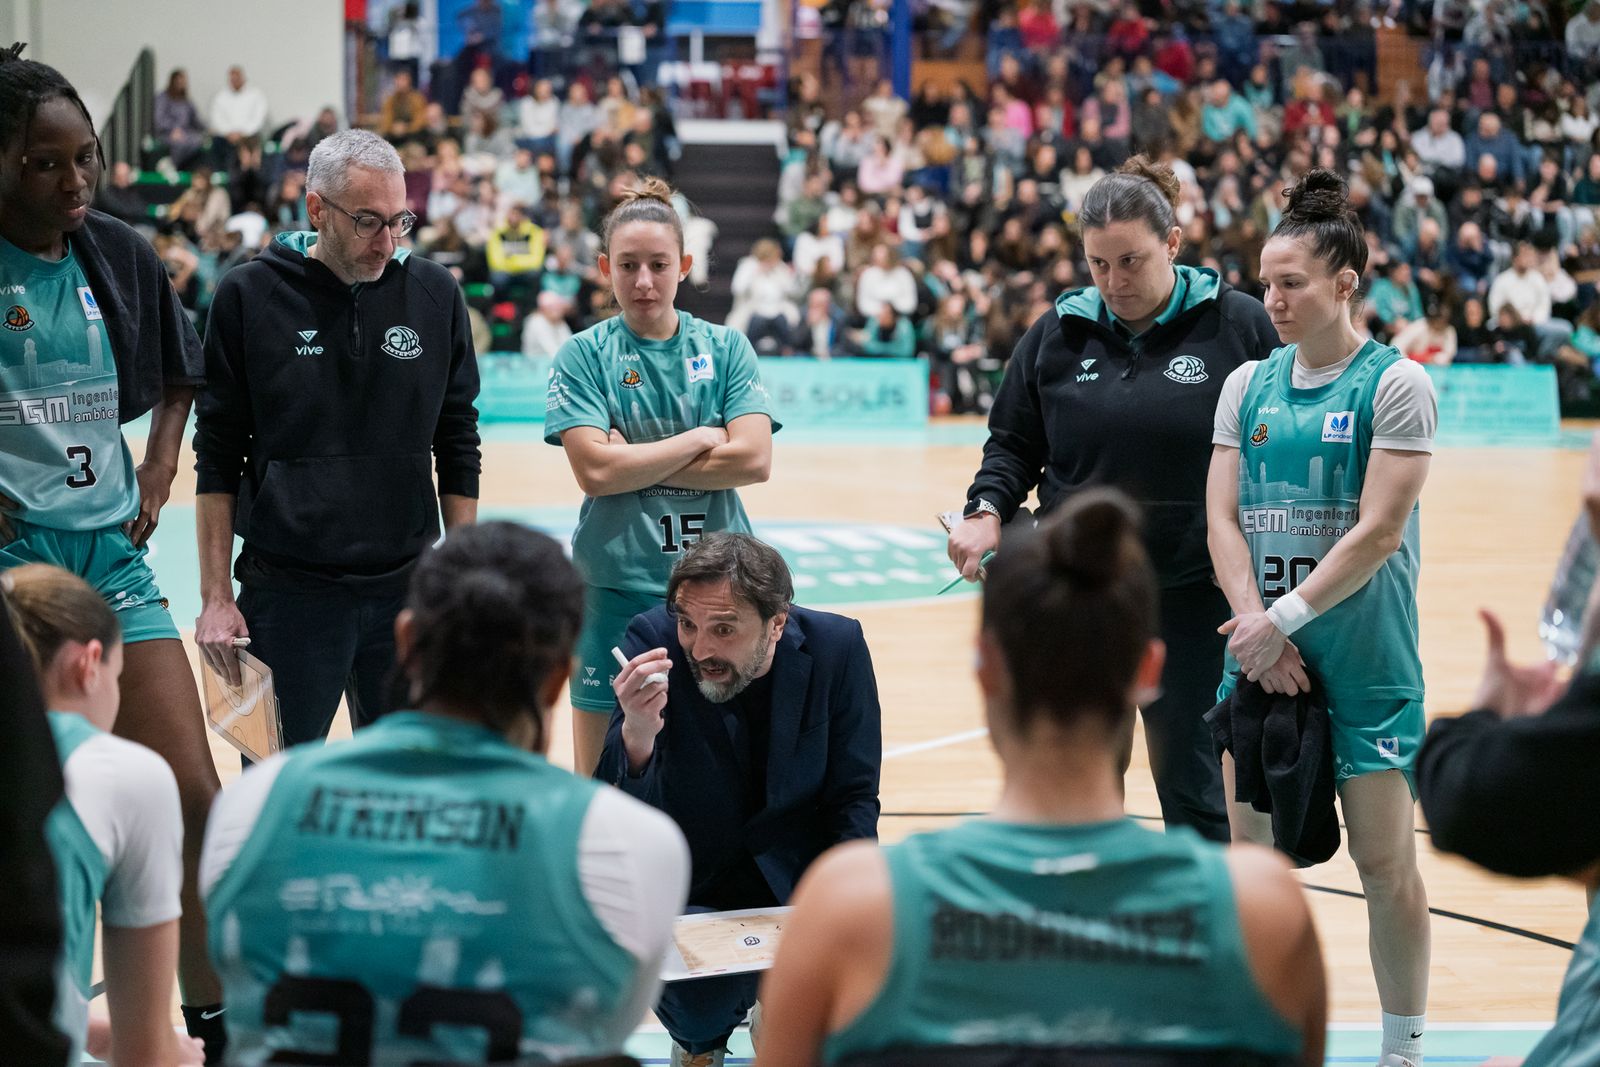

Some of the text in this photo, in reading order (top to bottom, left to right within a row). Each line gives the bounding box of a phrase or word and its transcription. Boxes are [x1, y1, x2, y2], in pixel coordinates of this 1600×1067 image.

[295, 345, 324, 355] vive
[618, 354, 640, 362] vive
[1076, 372, 1099, 382] vive
[1257, 406, 1280, 415] vive
[65, 444, 97, 490] 3
[1242, 507, 1288, 534] SGM
[659, 512, 707, 554] 15
[581, 677, 600, 687] vive
